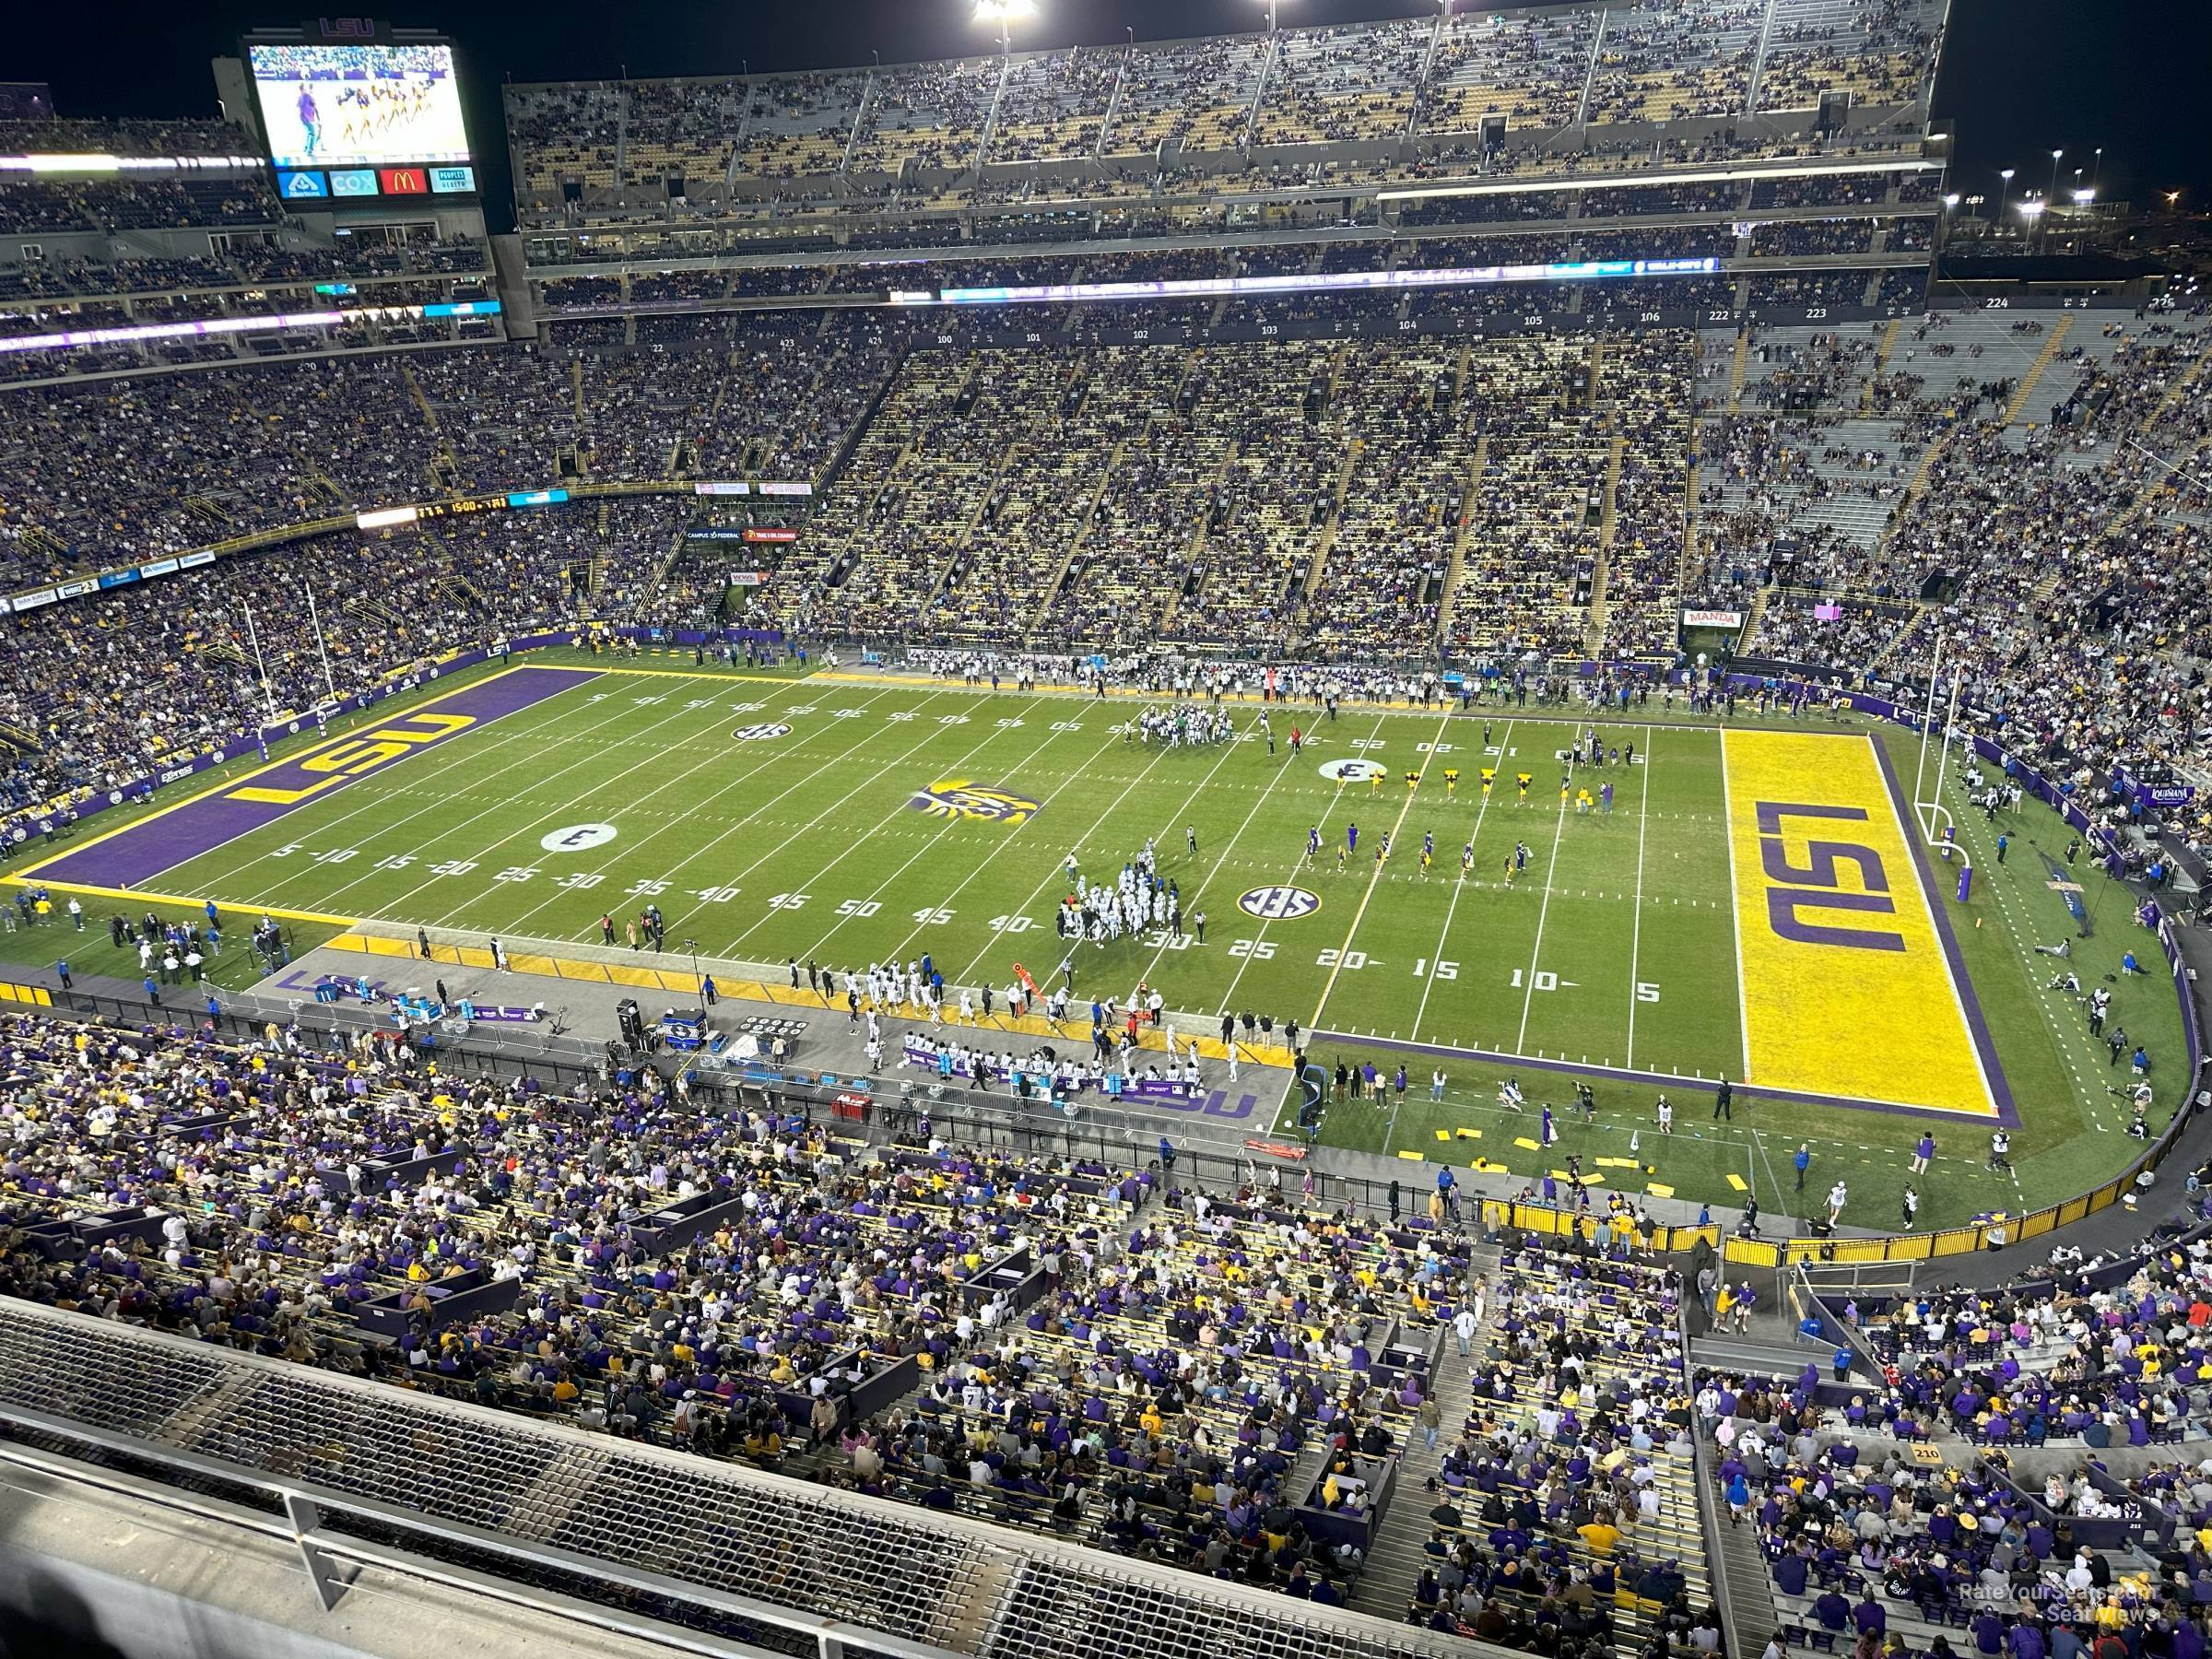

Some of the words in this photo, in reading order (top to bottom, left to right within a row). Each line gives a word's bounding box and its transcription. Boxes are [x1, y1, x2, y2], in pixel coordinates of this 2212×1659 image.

[319, 18, 375, 37] LSU
[333, 175, 375, 192] COX
[1986, 297, 2008, 309] 224
[1641, 312, 1660, 322] 106
[1709, 311, 1729, 321] 222
[1806, 308, 1827, 318] 223
[1398, 321, 1418, 331] 104
[1524, 315, 1543, 326] 105
[1133, 330, 1149, 340] 102
[1262, 325, 1278, 335] 103
[780, 338, 794, 347] 423
[867, 336, 882, 347] 424
[937, 335, 953, 345] 100
[1026, 333, 1041, 343] 101
[452, 500, 477, 513] 15:00
[64, 583, 83, 596] WBRZ
[1688, 610, 1736, 624] MANDA
[587, 693, 609, 702] 5
[633, 696, 667, 706] 10
[683, 700, 715, 709] 15
[730, 702, 767, 712] 20
[782, 705, 818, 715] 25
[833, 710, 868, 719] 30
[885, 712, 921, 722] 35
[938, 714, 972, 725] 40
[993, 718, 1026, 728] 45
[1048, 721, 1084, 732] 50
[1348, 738, 1386, 749] 25
[1416, 742, 1453, 753] 20
[1483, 747, 1518, 758] 15
[1630, 753, 1645, 764] 5
[223, 713, 477, 805] LSU
[160, 764, 194, 783] Express
[2151, 787, 2188, 801] LOUISIANA
[272, 844, 304, 857] 5
[314, 848, 360, 864] 10
[372, 854, 418, 870] 15
[429, 860, 479, 876] 20
[492, 866, 542, 882] 25
[1755, 800, 1907, 953] LSU
[558, 873, 606, 889] 30
[624, 878, 675, 896] 35
[696, 886, 742, 903] 40
[766, 892, 813, 911] 45
[1242, 886, 1318, 919] SEC
[834, 899, 884, 917] 50
[911, 907, 959, 924] 45
[987, 914, 1034, 933] 40
[1144, 930, 1194, 950] 30
[1228, 938, 1279, 959] 25
[1315, 948, 1368, 970] 20
[1412, 959, 1460, 980] 15
[1511, 968, 1559, 992] 10
[1141, 982, 1147, 992] 2
[1637, 982, 1660, 1003] 5
[2031, 1393, 2042, 1403] 13
[1915, 1448, 1940, 1460] 210
[1770, 1545, 1783, 1555] 11
